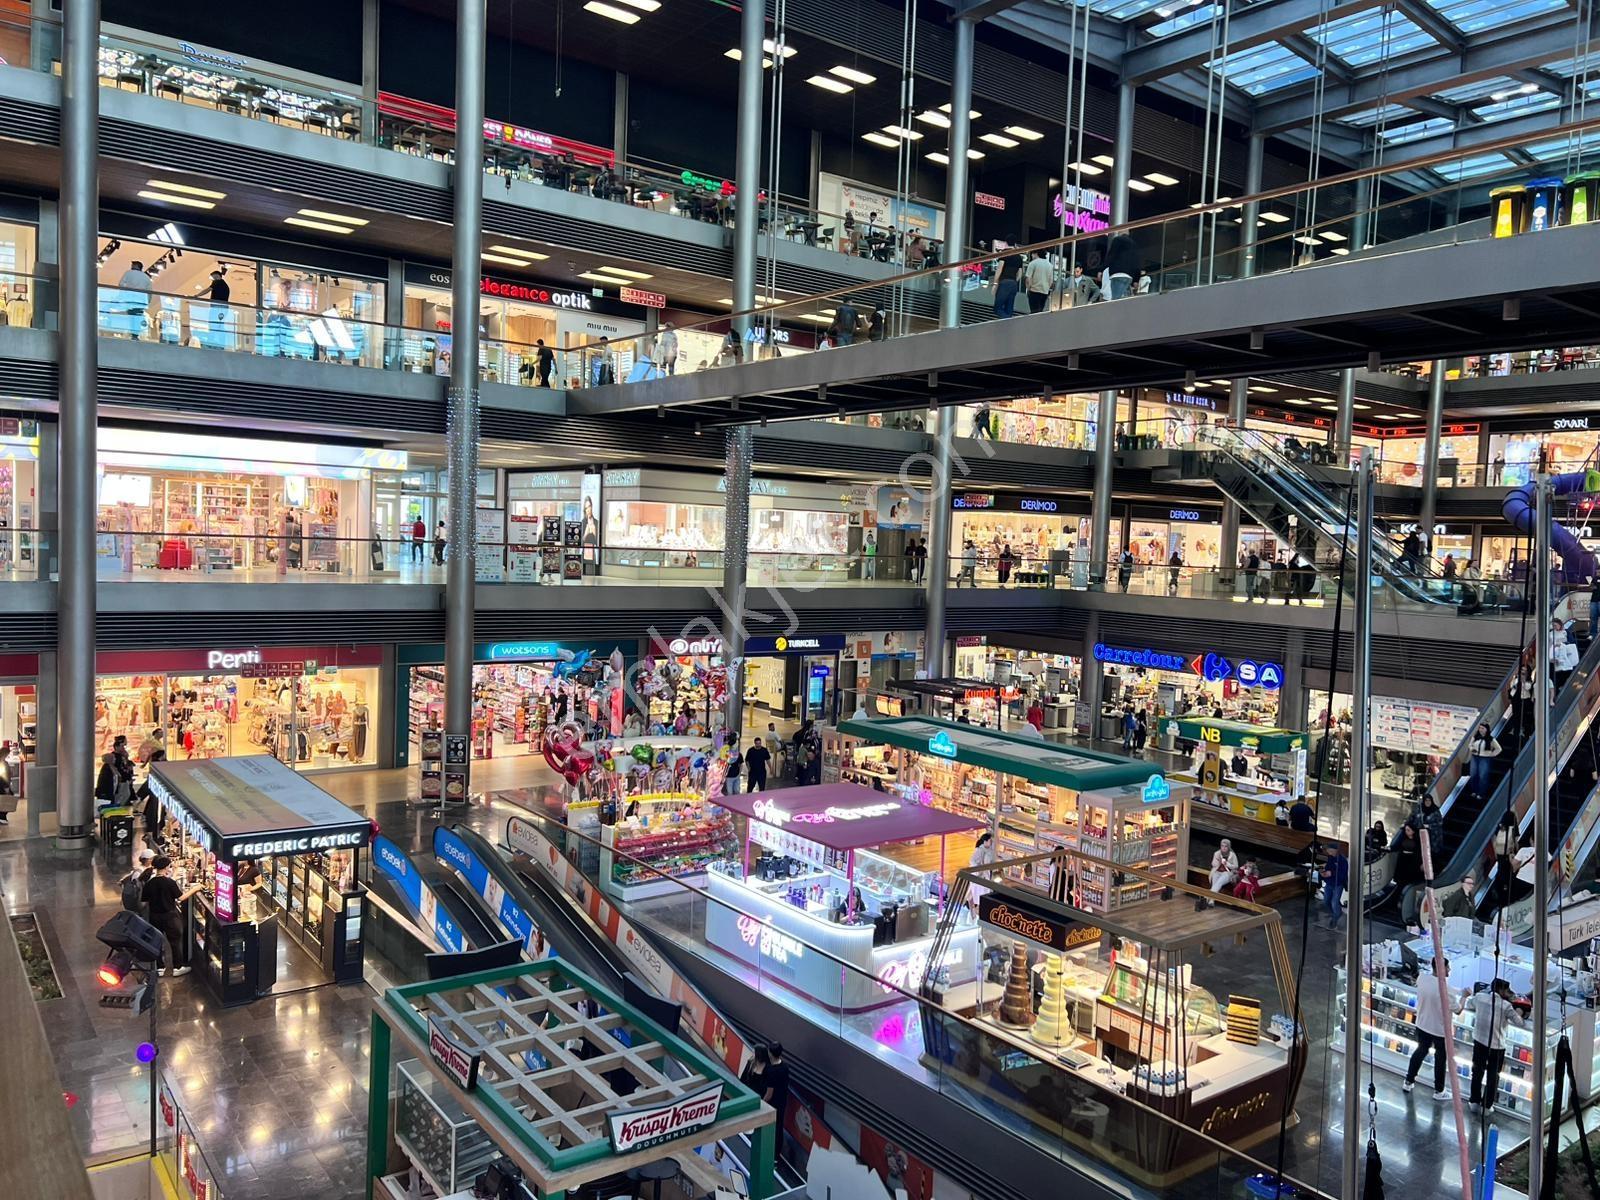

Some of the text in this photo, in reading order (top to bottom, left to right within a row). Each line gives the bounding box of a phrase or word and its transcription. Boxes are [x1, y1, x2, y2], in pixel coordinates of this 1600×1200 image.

[552, 292, 591, 311] optik
[502, 644, 550, 655] watsons
[788, 639, 820, 648] TURKCELL
[207, 650, 261, 670] Penti
[1094, 643, 1184, 670] Carrefour
[1201, 727, 1221, 743] NB
[232, 832, 361, 857] FREDERIC PATRIC
[633, 936, 662, 974] evidea
[620, 1093, 720, 1145] Krispy Kreme
[636, 1126, 700, 1151] DOUGHNUTS
